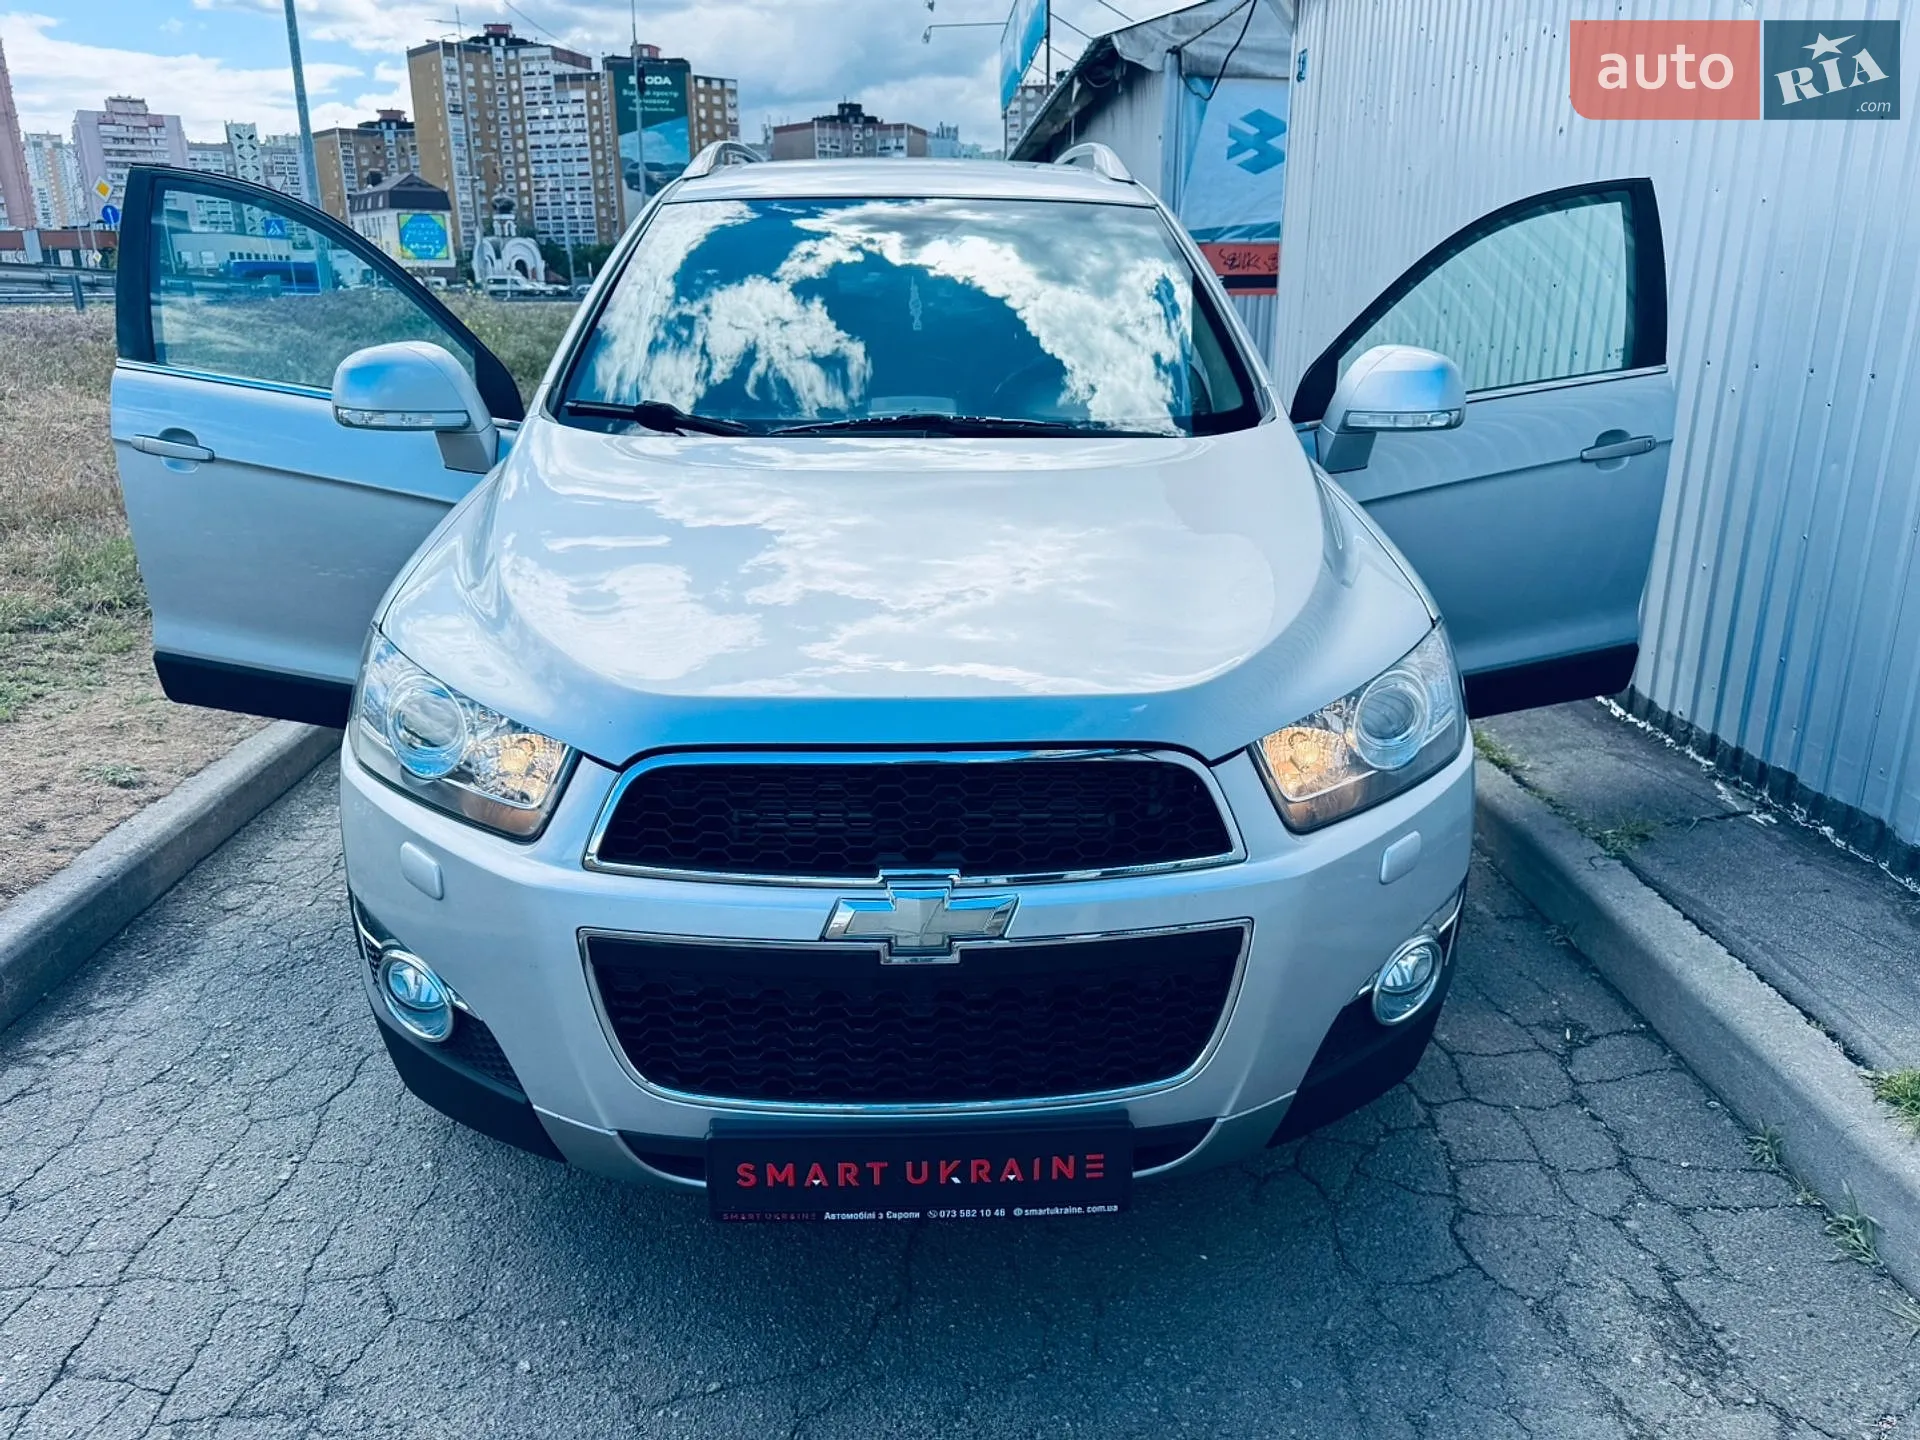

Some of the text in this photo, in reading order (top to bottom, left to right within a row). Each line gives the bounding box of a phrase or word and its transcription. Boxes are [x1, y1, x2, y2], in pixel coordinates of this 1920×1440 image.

[628, 75, 672, 86] SODA
[736, 1153, 1105, 1188] SMART UKRAINE
[824, 1211, 876, 1220] Автомобілі
[886, 1210, 920, 1221] Європи
[939, 1209, 957, 1218] 073
[980, 1208, 992, 1217] 10
